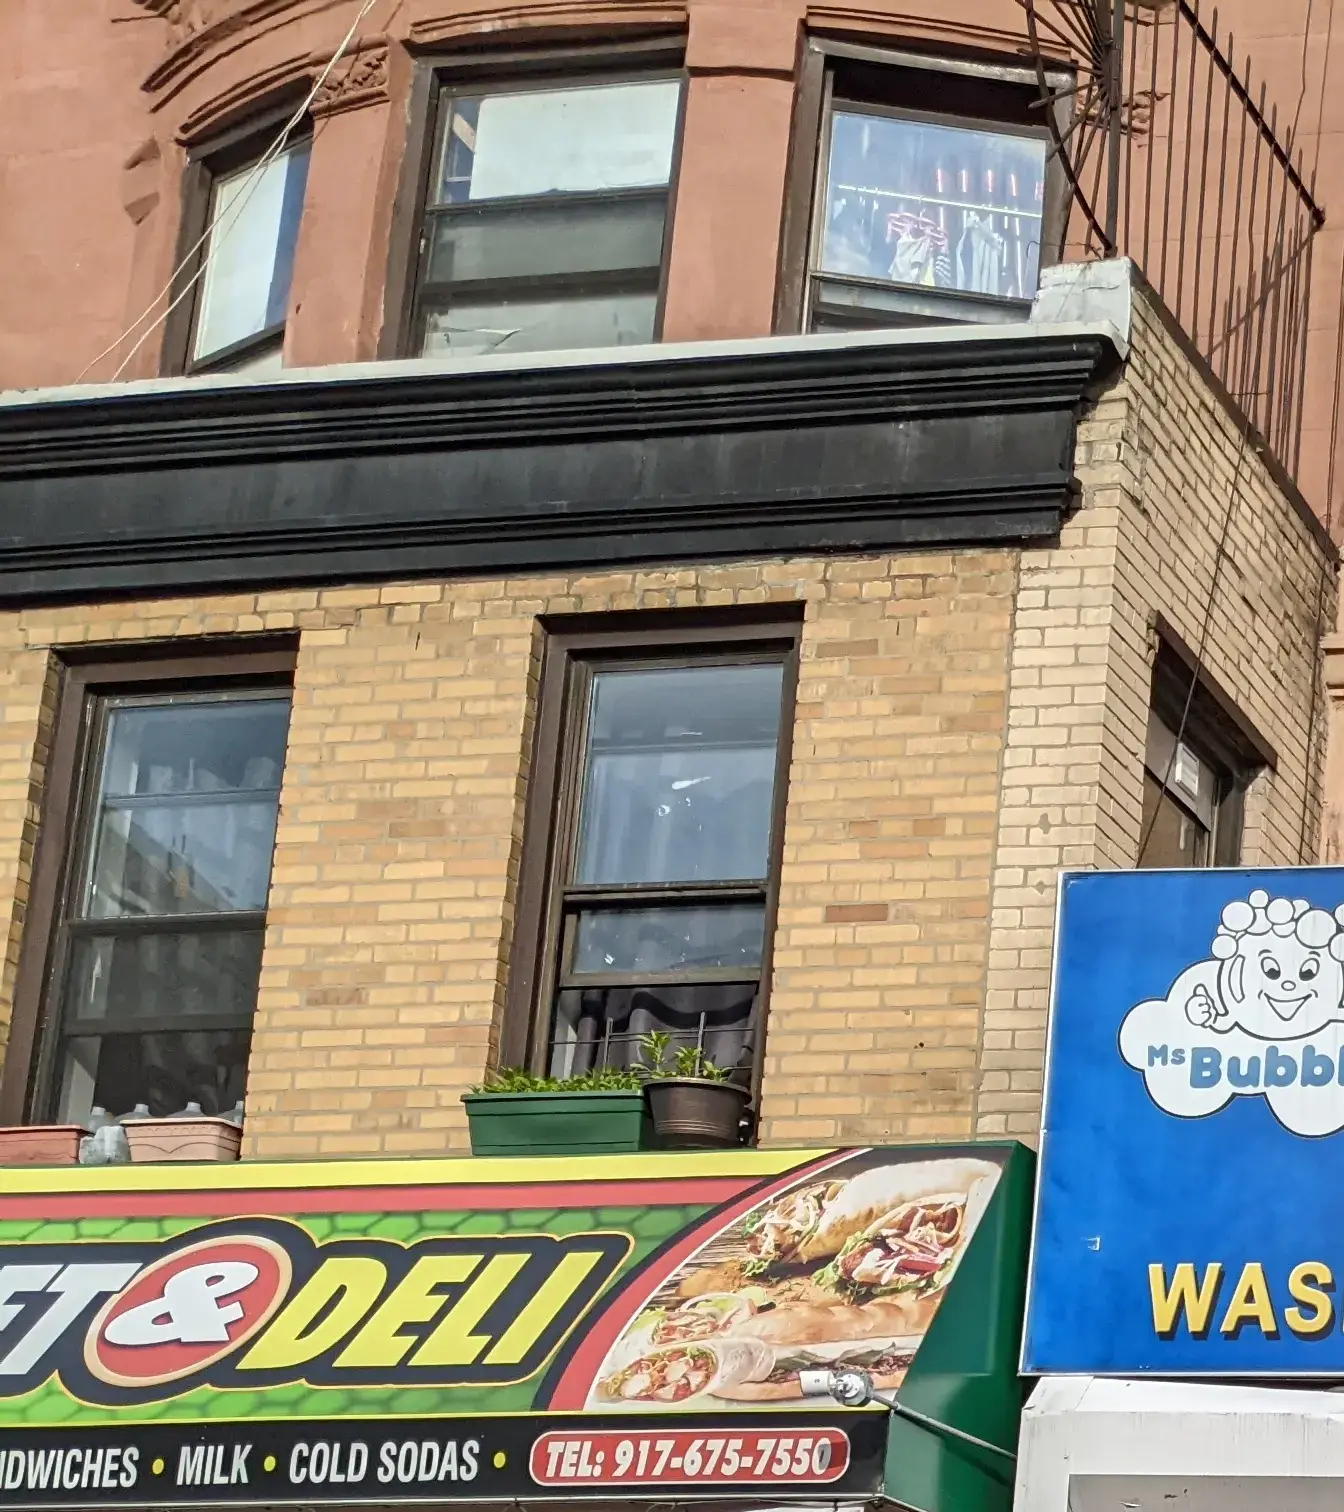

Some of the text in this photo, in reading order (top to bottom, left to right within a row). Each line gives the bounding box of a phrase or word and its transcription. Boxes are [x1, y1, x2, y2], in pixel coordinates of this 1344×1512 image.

[1147, 1044, 1185, 1067] Ms
[104, 1261, 259, 1345] &
[236, 1250, 603, 1369] DELI
[176, 1444, 252, 1483] MILK
[289, 1442, 367, 1484] COLD
[377, 1440, 480, 1482] SODAS
[546, 1437, 832, 1478] TEL: 917-675-7550
